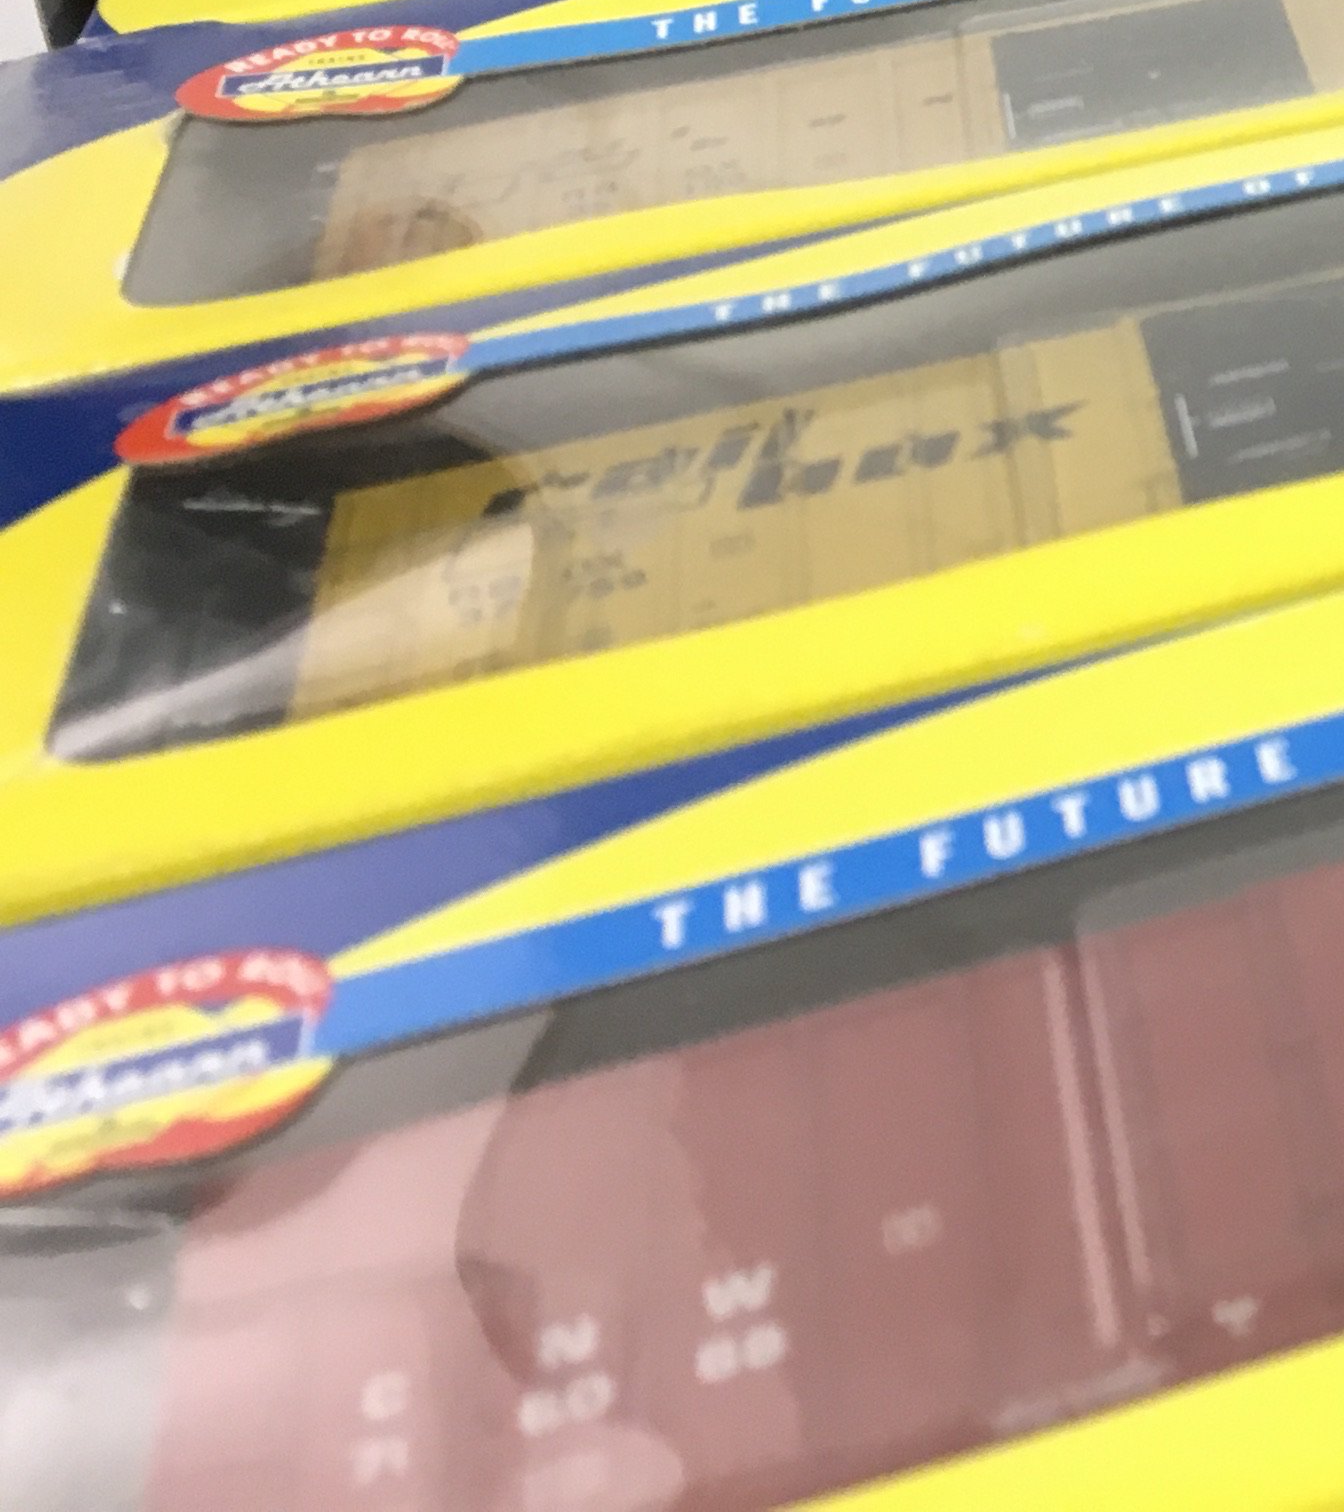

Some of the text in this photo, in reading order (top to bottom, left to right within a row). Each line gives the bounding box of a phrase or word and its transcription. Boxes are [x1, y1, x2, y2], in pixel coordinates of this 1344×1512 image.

[352, 28, 394, 44] TO
[651, 1, 760, 42] THE
[713, 280, 843, 323] THE
[906, 191, 1183, 281] FUTURE
[1242, 168, 1315, 199] OF
[652, 860, 836, 954] THE
[917, 739, 1298, 879] FUTURE
